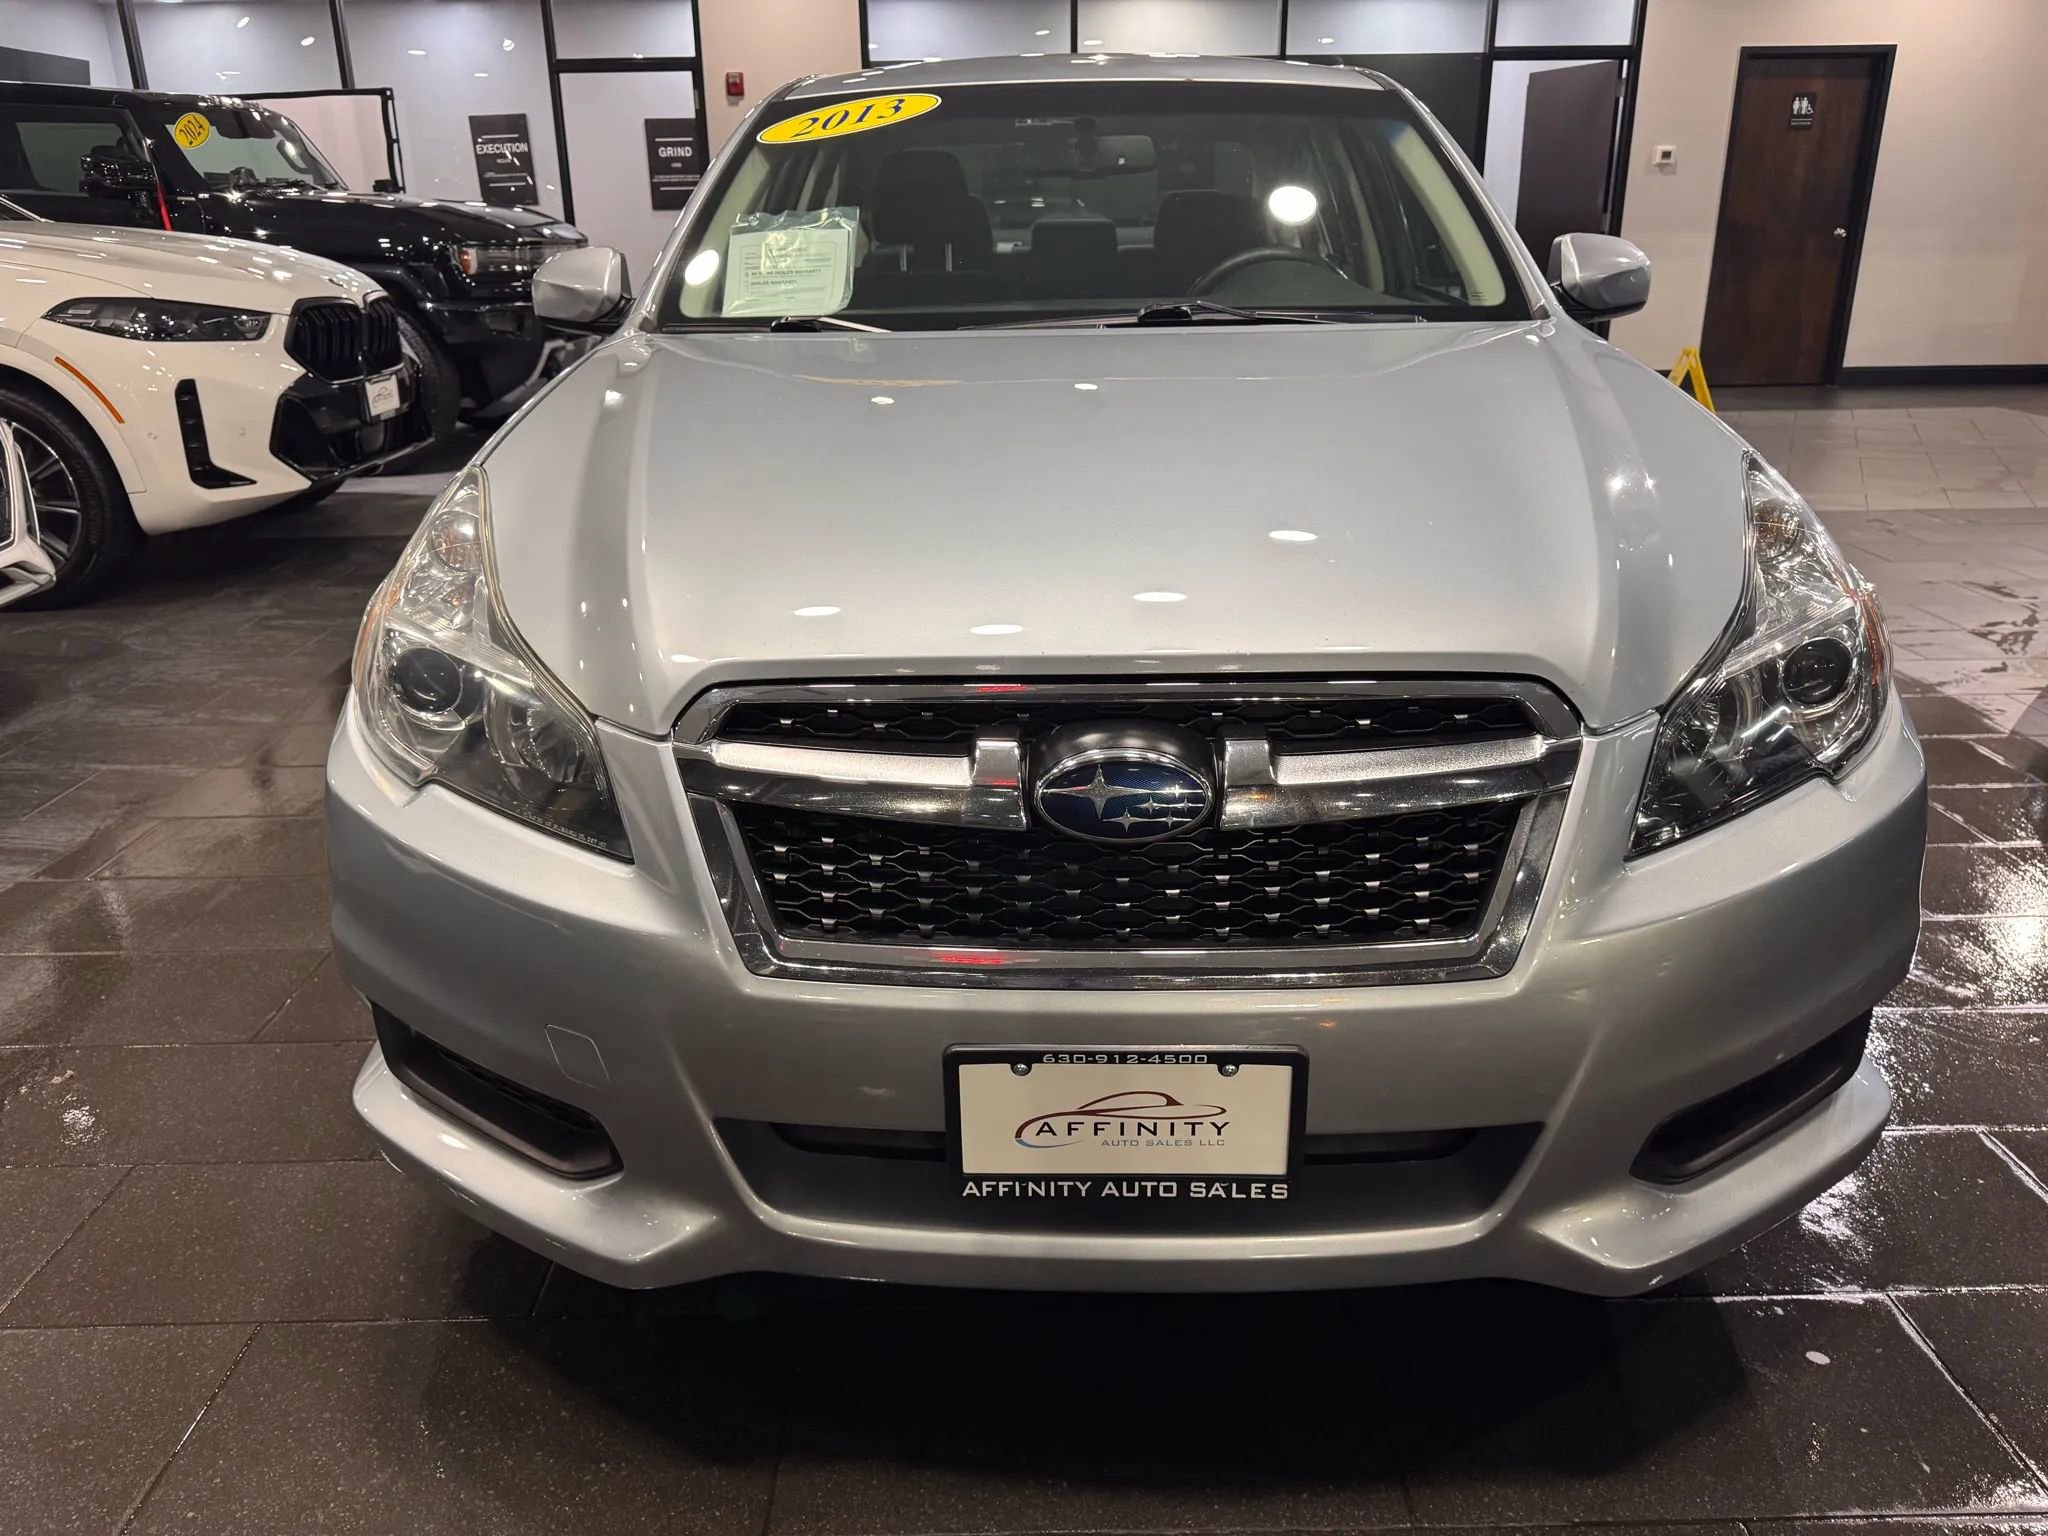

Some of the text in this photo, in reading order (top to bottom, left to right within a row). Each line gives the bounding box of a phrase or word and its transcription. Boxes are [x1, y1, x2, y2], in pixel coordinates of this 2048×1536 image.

[789, 98, 907, 139] 2013
[179, 115, 205, 145] 2024
[475, 142, 528, 154] EXECUTION
[658, 146, 693, 157] GRIND
[1042, 1054, 1208, 1065] 630-912-4500
[1035, 1121, 1230, 1137] AFFINITY
[1101, 1139, 1225, 1147] AUTO SALES LLC
[962, 1181, 1288, 1199] AFFINITY AUTO SALES
